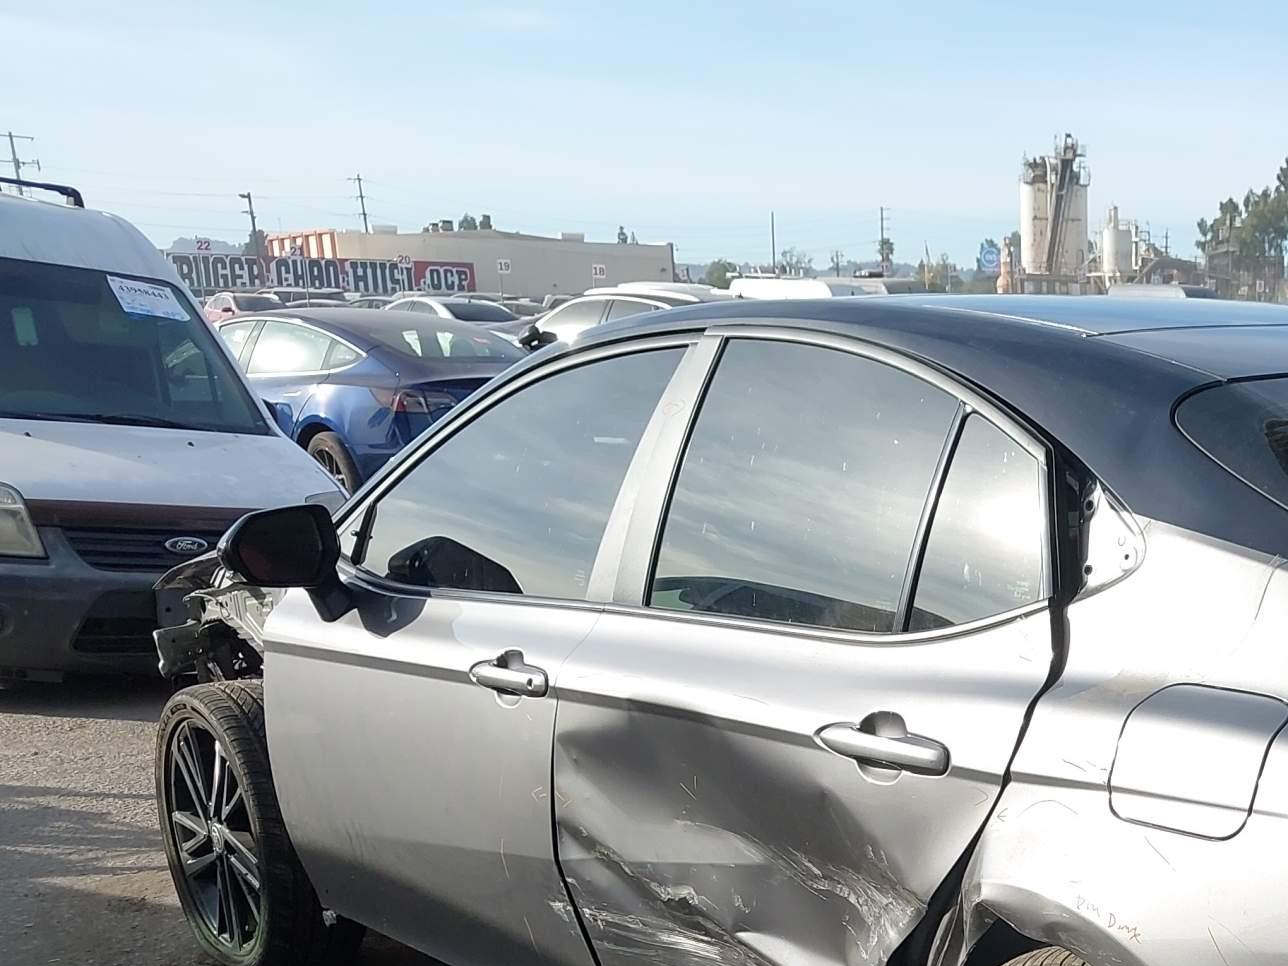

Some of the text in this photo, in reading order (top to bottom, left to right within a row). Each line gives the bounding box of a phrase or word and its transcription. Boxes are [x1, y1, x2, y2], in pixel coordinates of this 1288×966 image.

[196, 240, 210, 251] 22
[398, 254, 411, 264] 20
[498, 261, 510, 272] 19
[593, 266, 605, 276] 18
